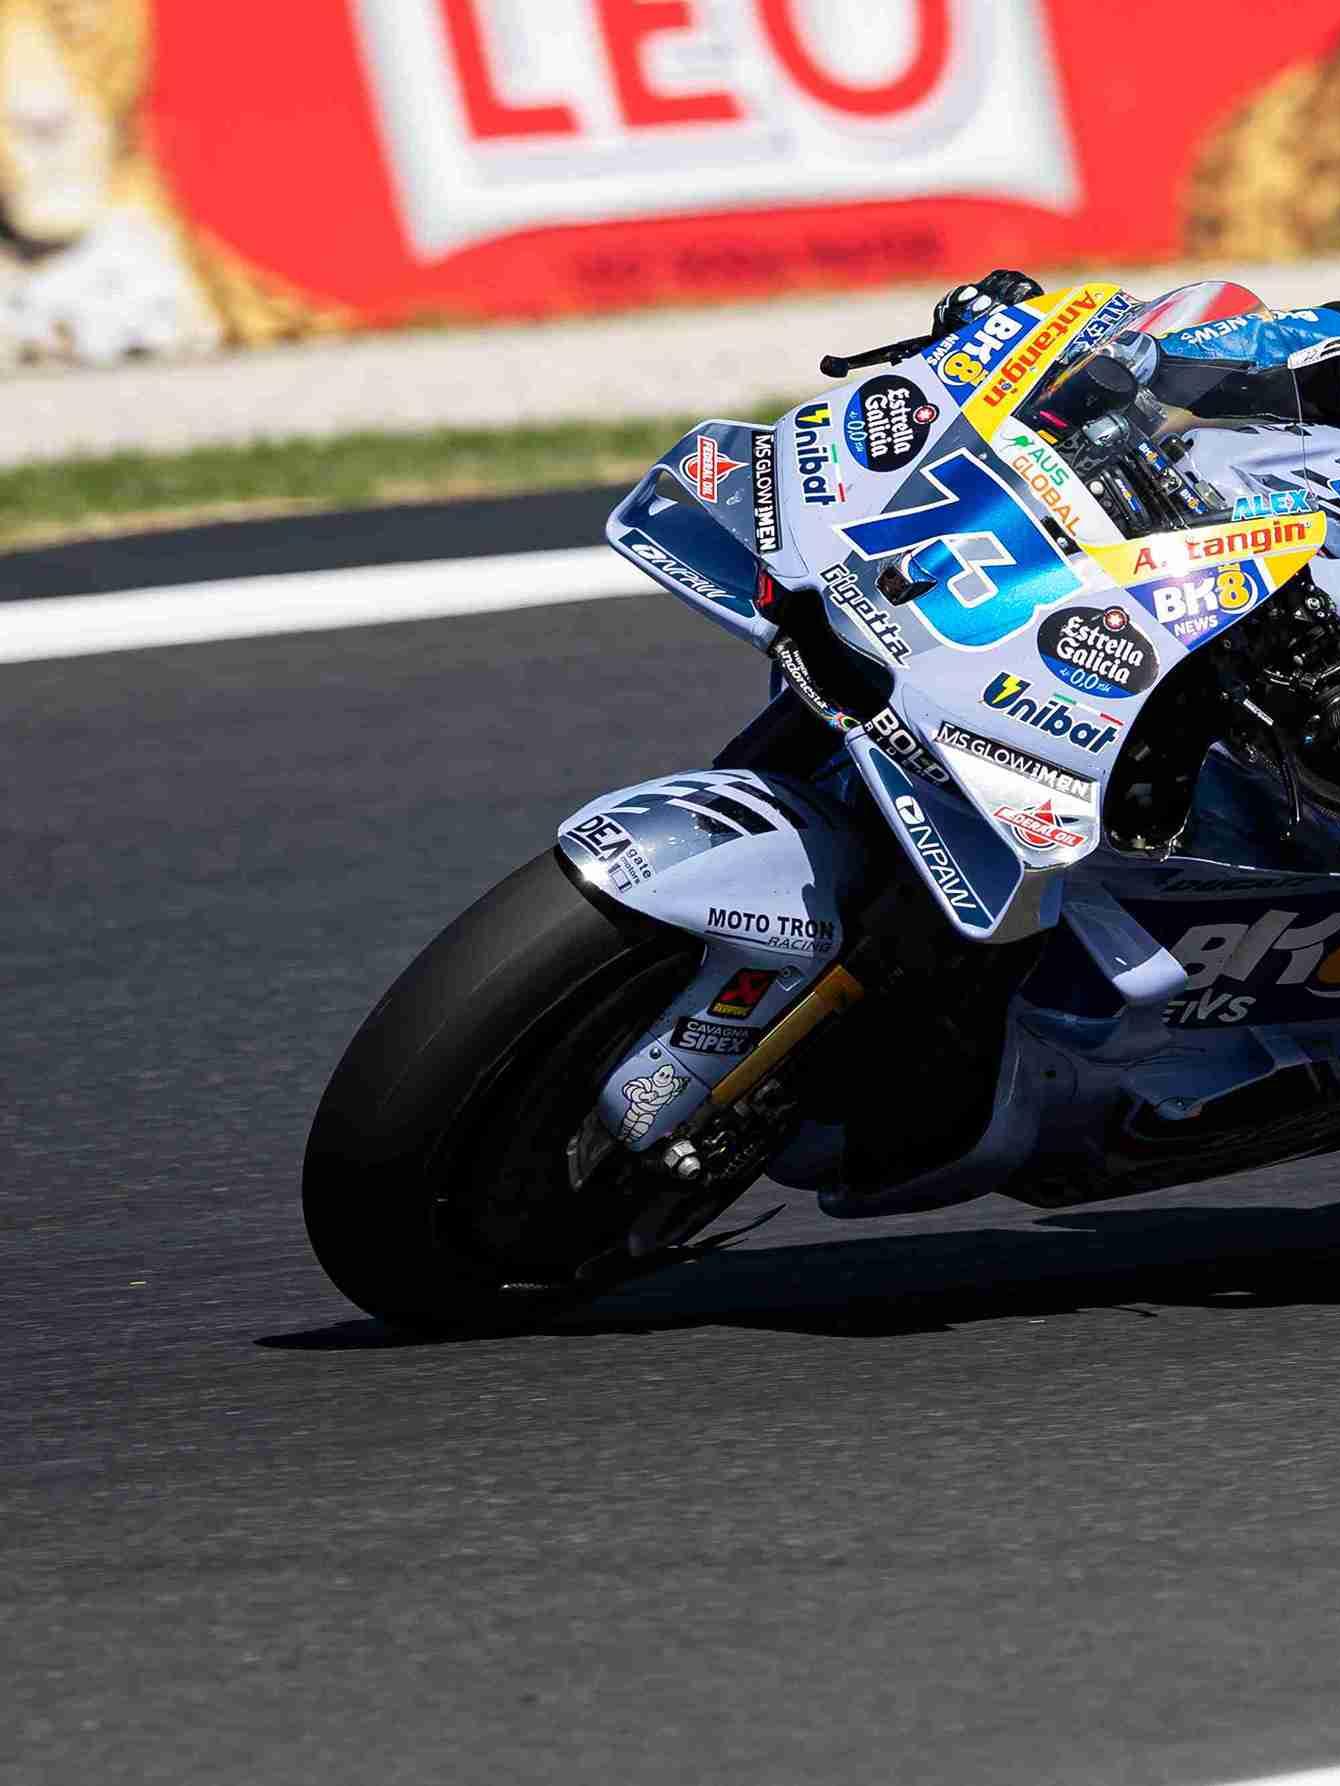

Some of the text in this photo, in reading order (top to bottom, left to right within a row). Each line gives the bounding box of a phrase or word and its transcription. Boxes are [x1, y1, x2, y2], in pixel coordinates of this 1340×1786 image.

[927, 333, 960, 367] NEWS
[865, 394, 893, 458] Galicia
[888, 388, 914, 455] Estrella
[755, 434, 774, 461] MS
[795, 402, 837, 506] Unibat
[1029, 448, 1069, 486] AUS
[755, 461, 775, 504] GLOW
[1012, 455, 1082, 536] GLOBAL
[1231, 490, 1311, 521] ALEX
[832, 446, 1086, 652] 73
[1133, 520, 1307, 575] Atangin
[1154, 570, 1252, 624] BK8
[1061, 615, 1144, 667] Estrella
[1174, 615, 1219, 638] NEWS
[1056, 636, 1131, 684] Galicia
[983, 671, 1118, 754] Unibat
[871, 706, 950, 783] BOLD
[938, 722, 971, 749] MS
[970, 739, 1033, 774] GLOW
[628, 848, 652, 880] gate
[707, 907, 834, 939] MOTO TRON
[767, 935, 832, 953] RACING
[678, 1032, 746, 1053] SIPEX
